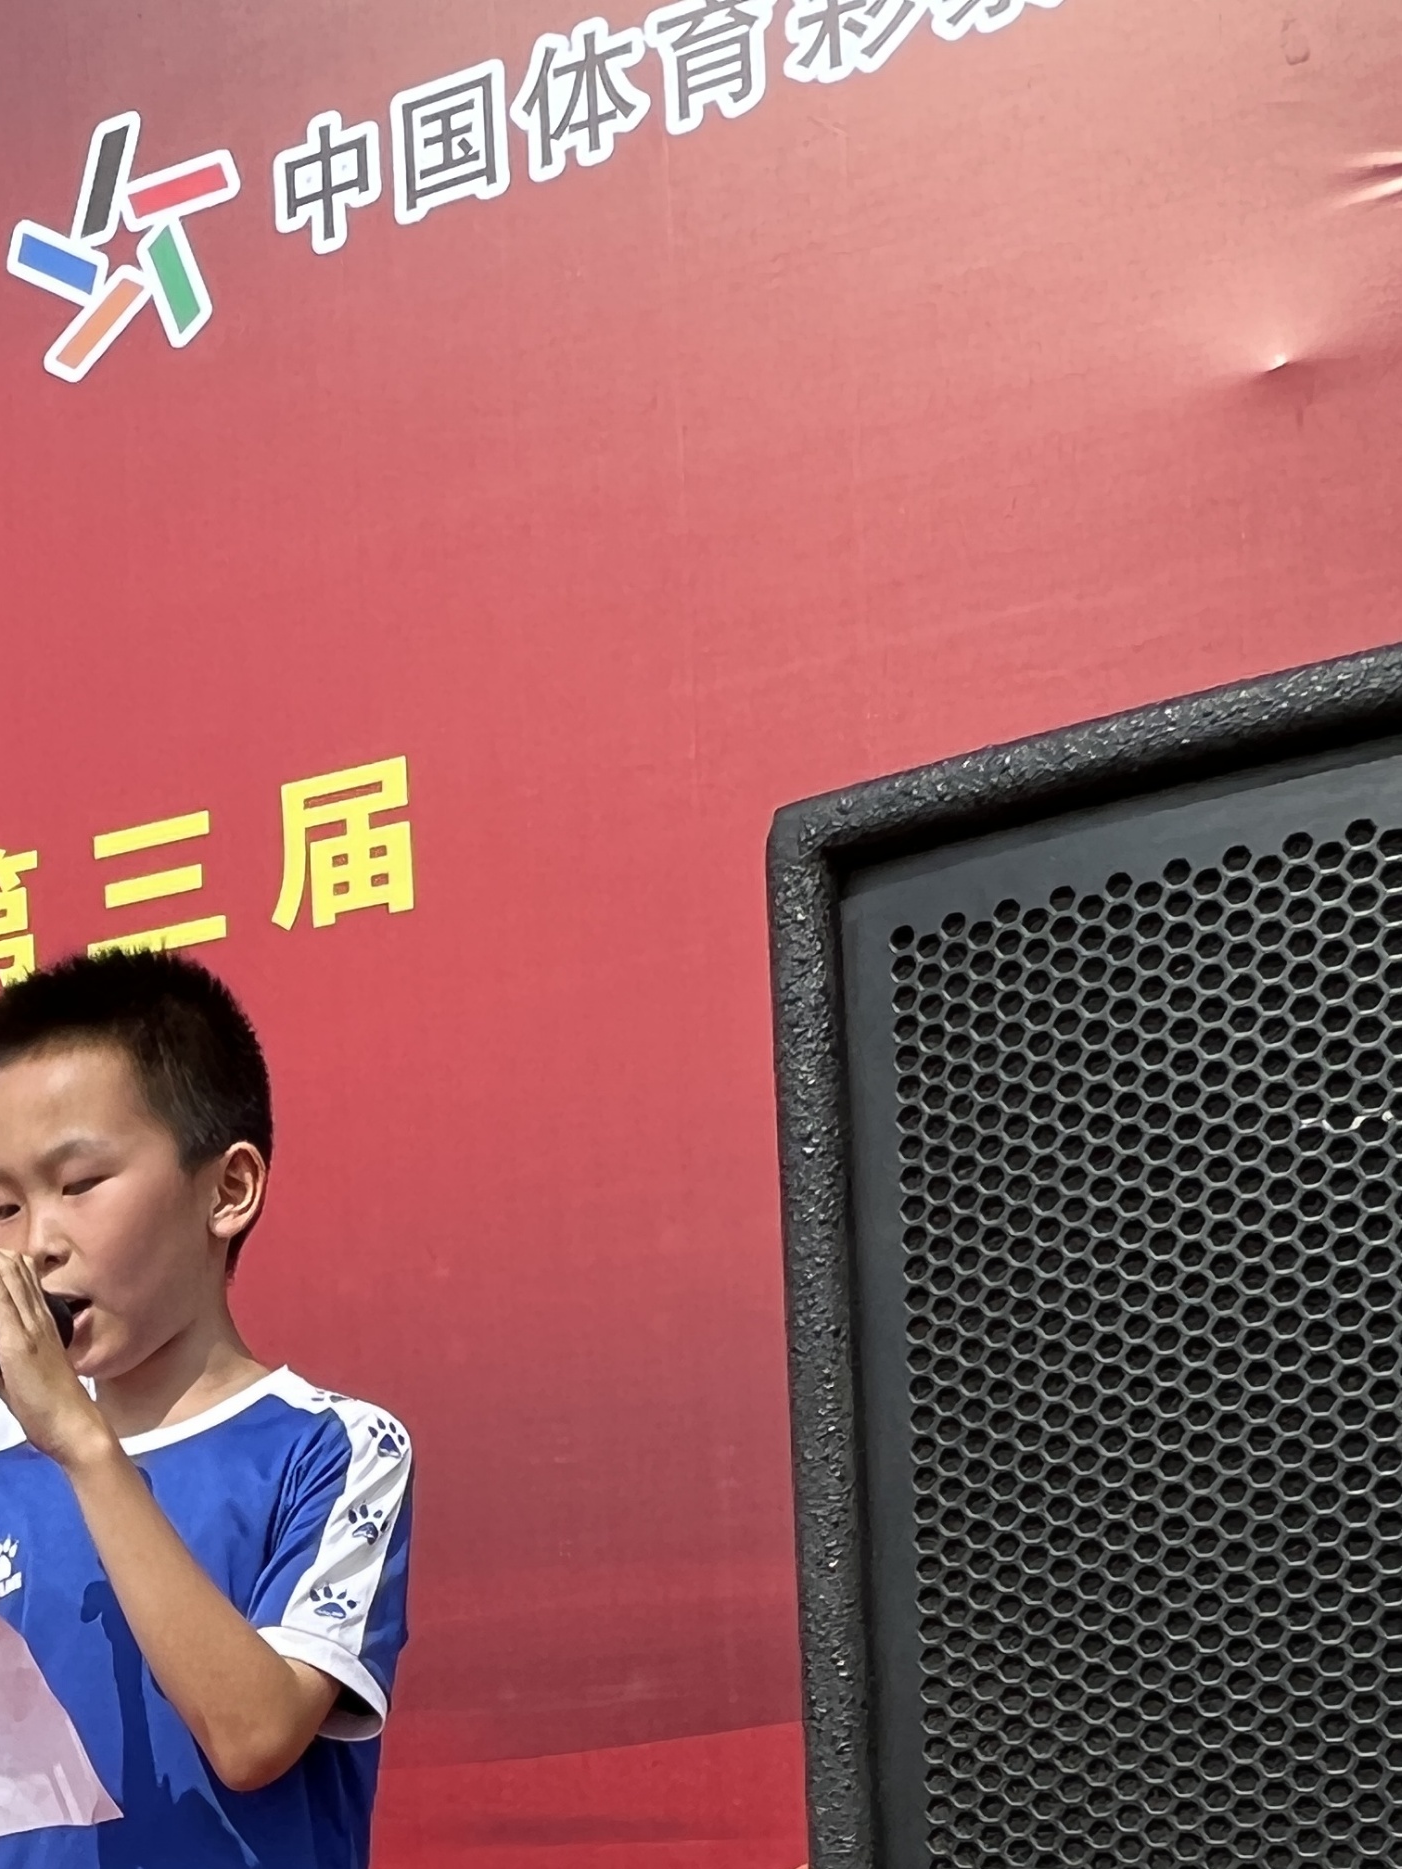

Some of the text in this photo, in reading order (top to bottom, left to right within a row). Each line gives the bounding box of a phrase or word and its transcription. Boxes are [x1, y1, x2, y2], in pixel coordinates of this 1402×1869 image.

[275, 0, 1064, 253] 中国体育彩
